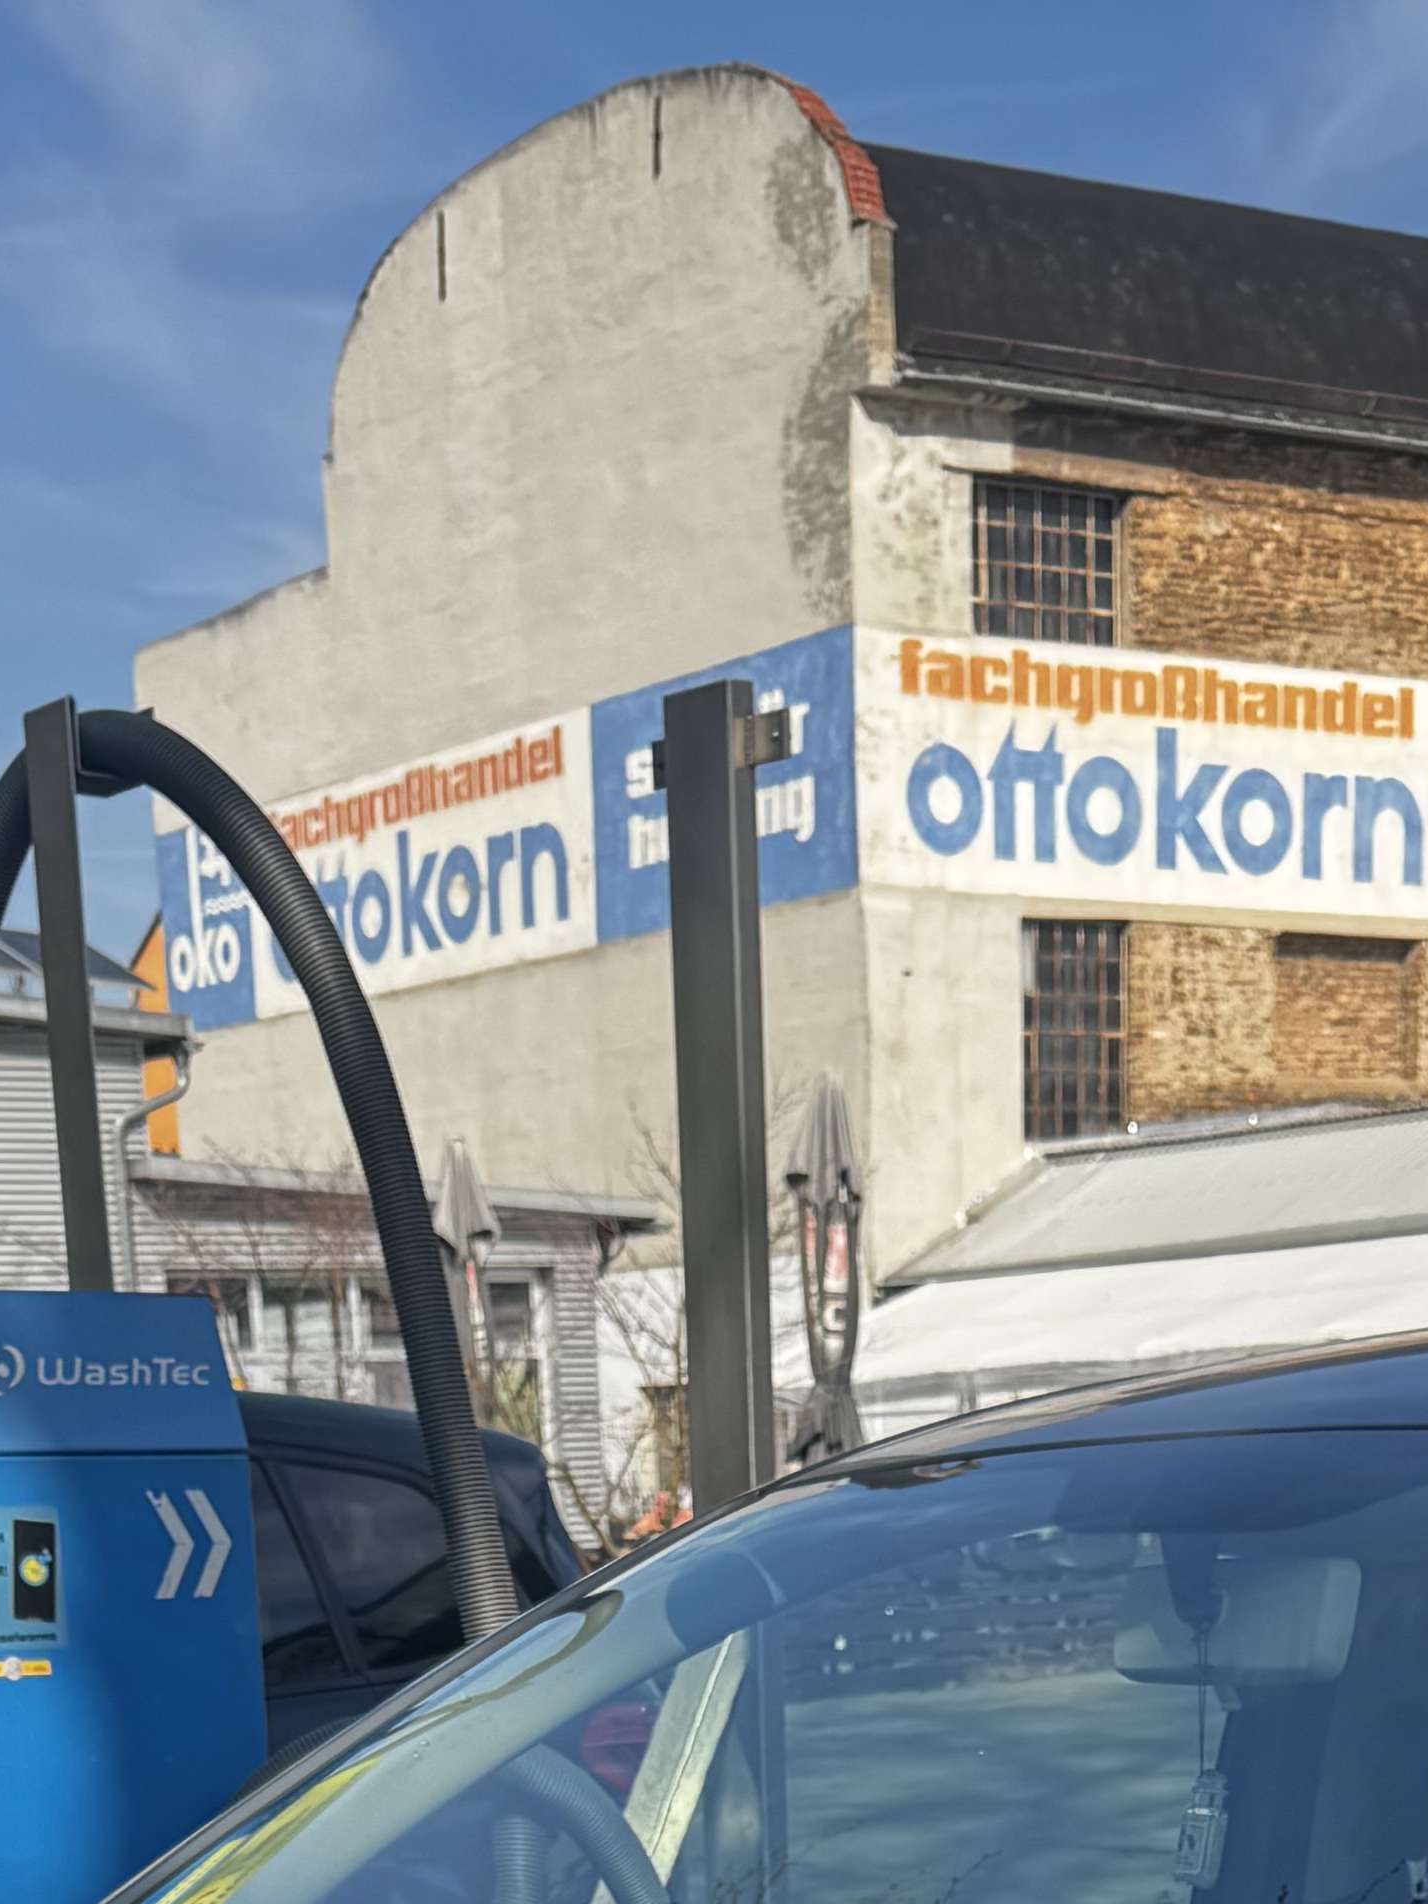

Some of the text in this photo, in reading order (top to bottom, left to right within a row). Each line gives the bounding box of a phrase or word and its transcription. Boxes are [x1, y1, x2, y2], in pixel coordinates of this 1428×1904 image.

[900, 639, 1415, 740] fachgroßhandel
[275, 723, 563, 853] achgroßhandel
[906, 718, 1424, 886] ottokorn
[36, 1356, 211, 1387] WashTec
